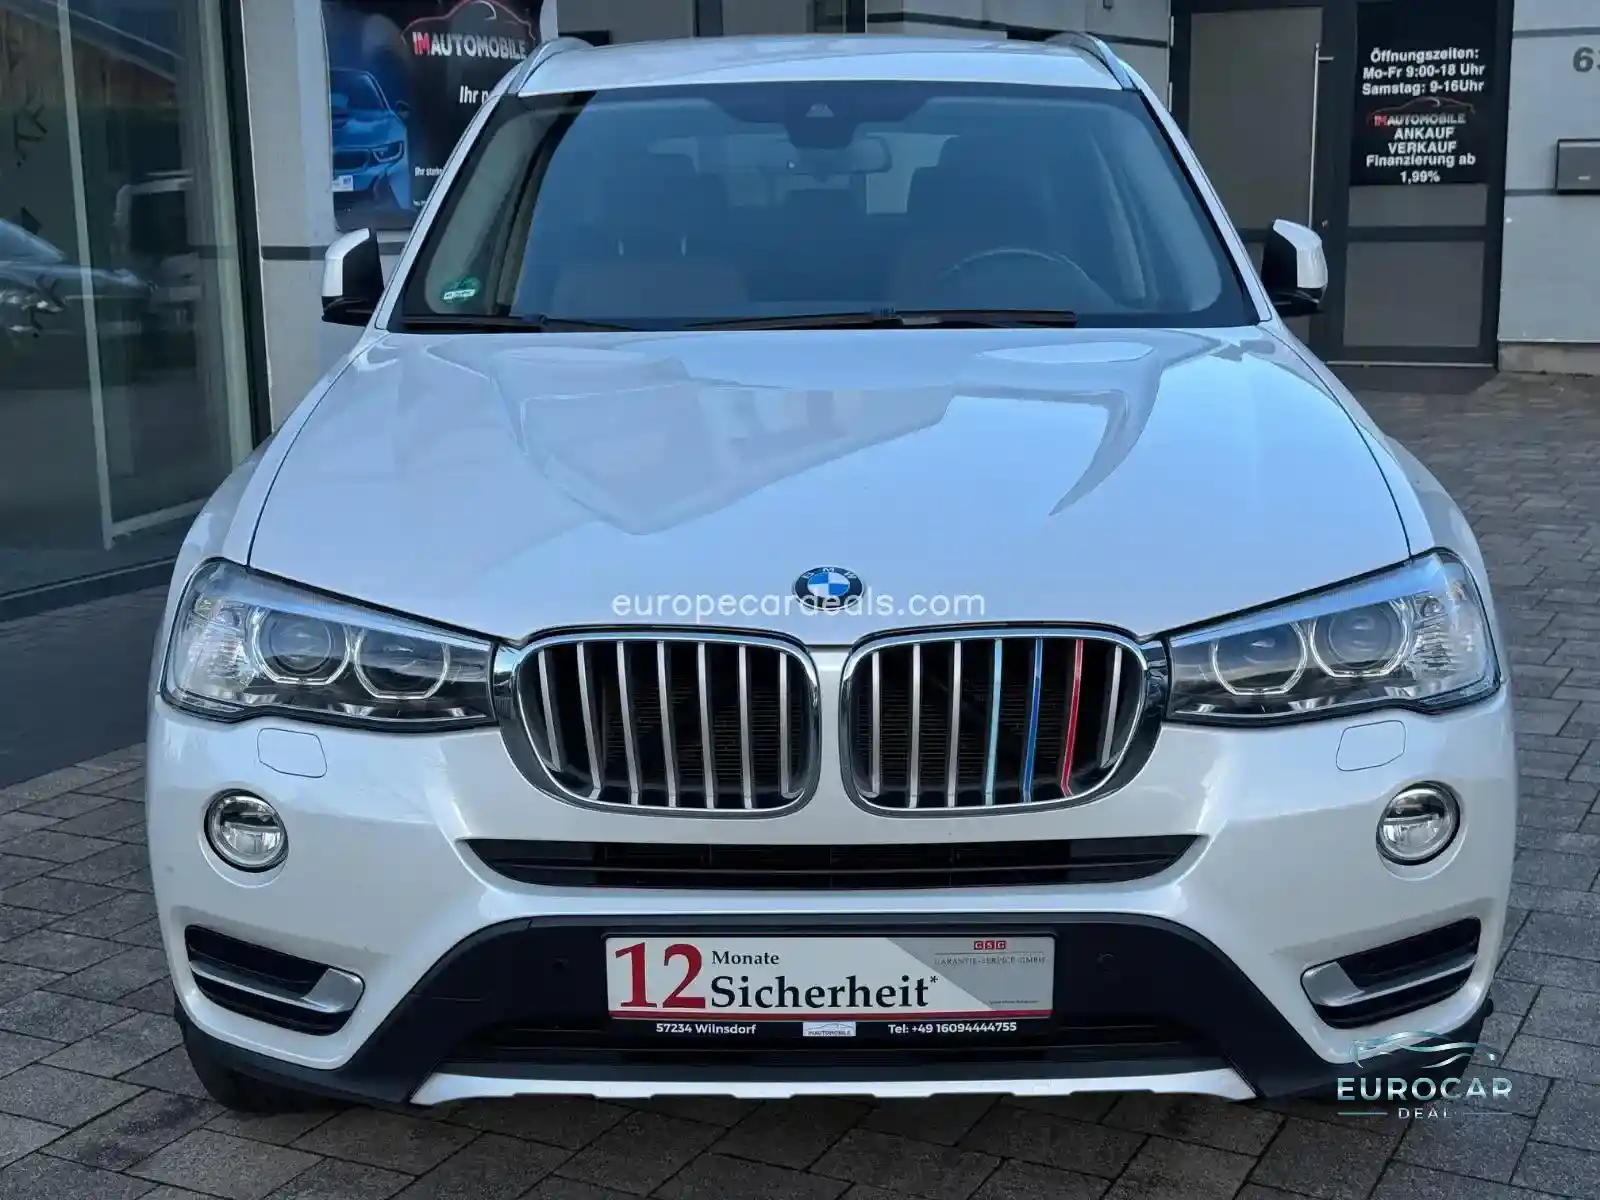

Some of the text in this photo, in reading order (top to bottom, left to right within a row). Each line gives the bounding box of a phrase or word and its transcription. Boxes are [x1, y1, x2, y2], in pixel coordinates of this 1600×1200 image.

[1370, 47, 1480, 64] Öffnungszeiten:
[1572, 46, 1600, 73] 6
[1363, 63, 1486, 79] Mo-Fr 9:00-18 Uhr
[460, 85, 479, 104] Ihr
[1362, 80, 1485, 96] Samstag: 9-16Uhr
[1394, 126, 1455, 141] ANKAUF
[1388, 140, 1457, 155] VERKAUF
[1366, 152, 1476, 168] Finanzierung ab
[1400, 170, 1441, 184] 1,99%
[974, 940, 1006, 950] GSG
[711, 950, 780, 965] Monate
[615, 942, 706, 1008] 12
[656, 1022, 757, 1035] 57234 Wilnsdorf
[888, 1021, 1017, 1034] Tel: +49 16094444755
